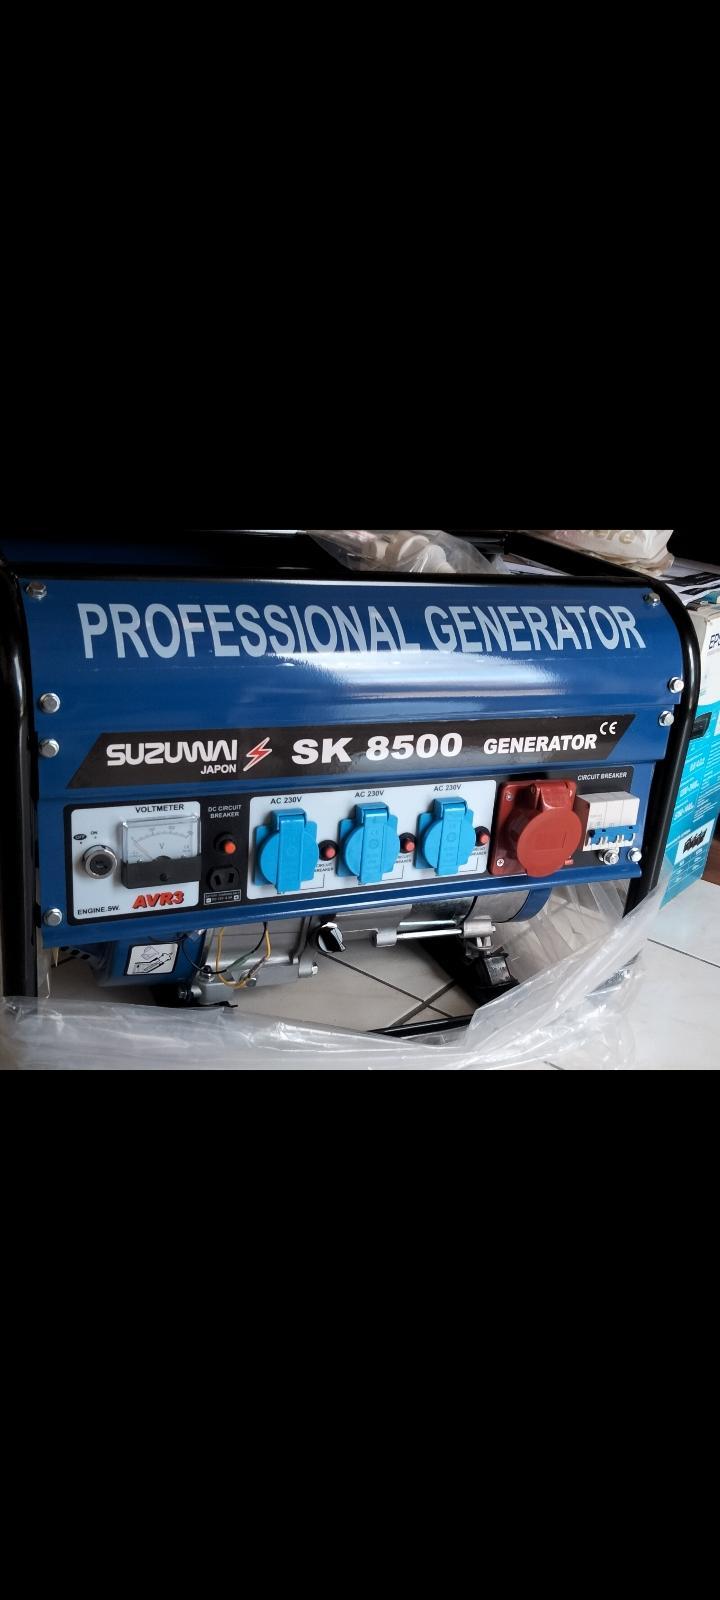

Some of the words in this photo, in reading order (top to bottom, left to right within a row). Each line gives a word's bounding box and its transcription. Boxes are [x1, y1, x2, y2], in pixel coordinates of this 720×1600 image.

[77, 603, 420, 659] PROFESSIONAL
[424, 605, 647, 652] GENERATOR
[291, 737, 353, 765] SK
[366, 733, 463, 761] 8500
[483, 733, 598, 755] GENERATOR
[200, 764, 237, 775] JAPON
[577, 773, 600, 781] CIRCUIT
[601, 771, 627, 779] BREAKER
[445, 783, 462, 791] 230V
[270, 797, 282, 805] AC
[283, 796, 302, 804] 230V
[135, 803, 185, 813] VOLTMETER
[218, 804, 242, 812] CIRCUIT
[210, 811, 240, 819] BREAKER
[132, 890, 185, 910] AVR3
